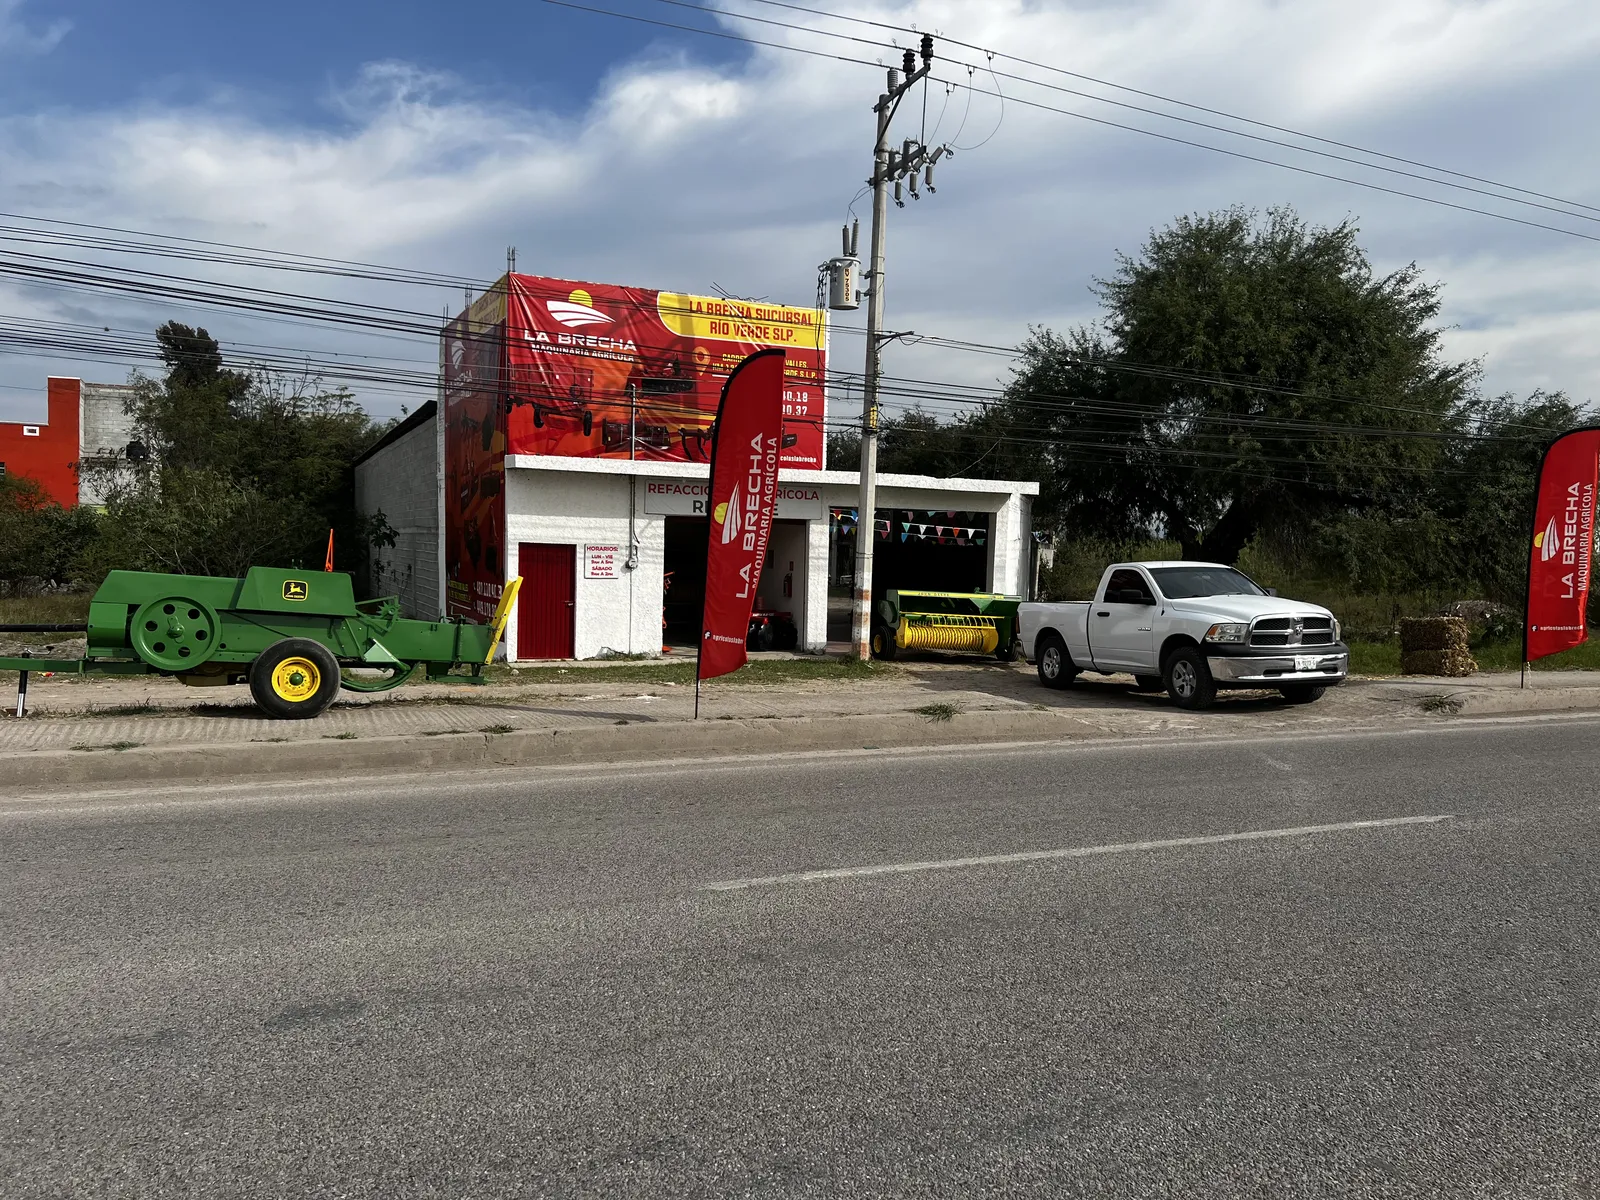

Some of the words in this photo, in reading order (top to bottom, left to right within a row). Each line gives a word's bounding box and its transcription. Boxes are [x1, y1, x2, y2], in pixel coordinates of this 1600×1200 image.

[690, 301, 703, 313] LA
[707, 302, 754, 318] BRECHA
[756, 308, 812, 326] SUCURSAL
[710, 319, 730, 335] RÍO
[733, 323, 770, 339] VERDE
[773, 327, 797, 342] SLP.
[524, 330, 550, 343] LA
[558, 333, 637, 351] BRECHA
[743, 432, 763, 551] BRECHA
[1579, 484, 1593, 531] AGRÍCOLA
[752, 506, 771, 589] MAQUINARIA
[763, 437, 778, 503] AGRÍCOLA
[1562, 482, 1580, 565] BRECHA
[736, 562, 752, 598] LA
[1577, 530, 1590, 591] MAQUINARIA
[1560, 572, 1574, 599] LA
